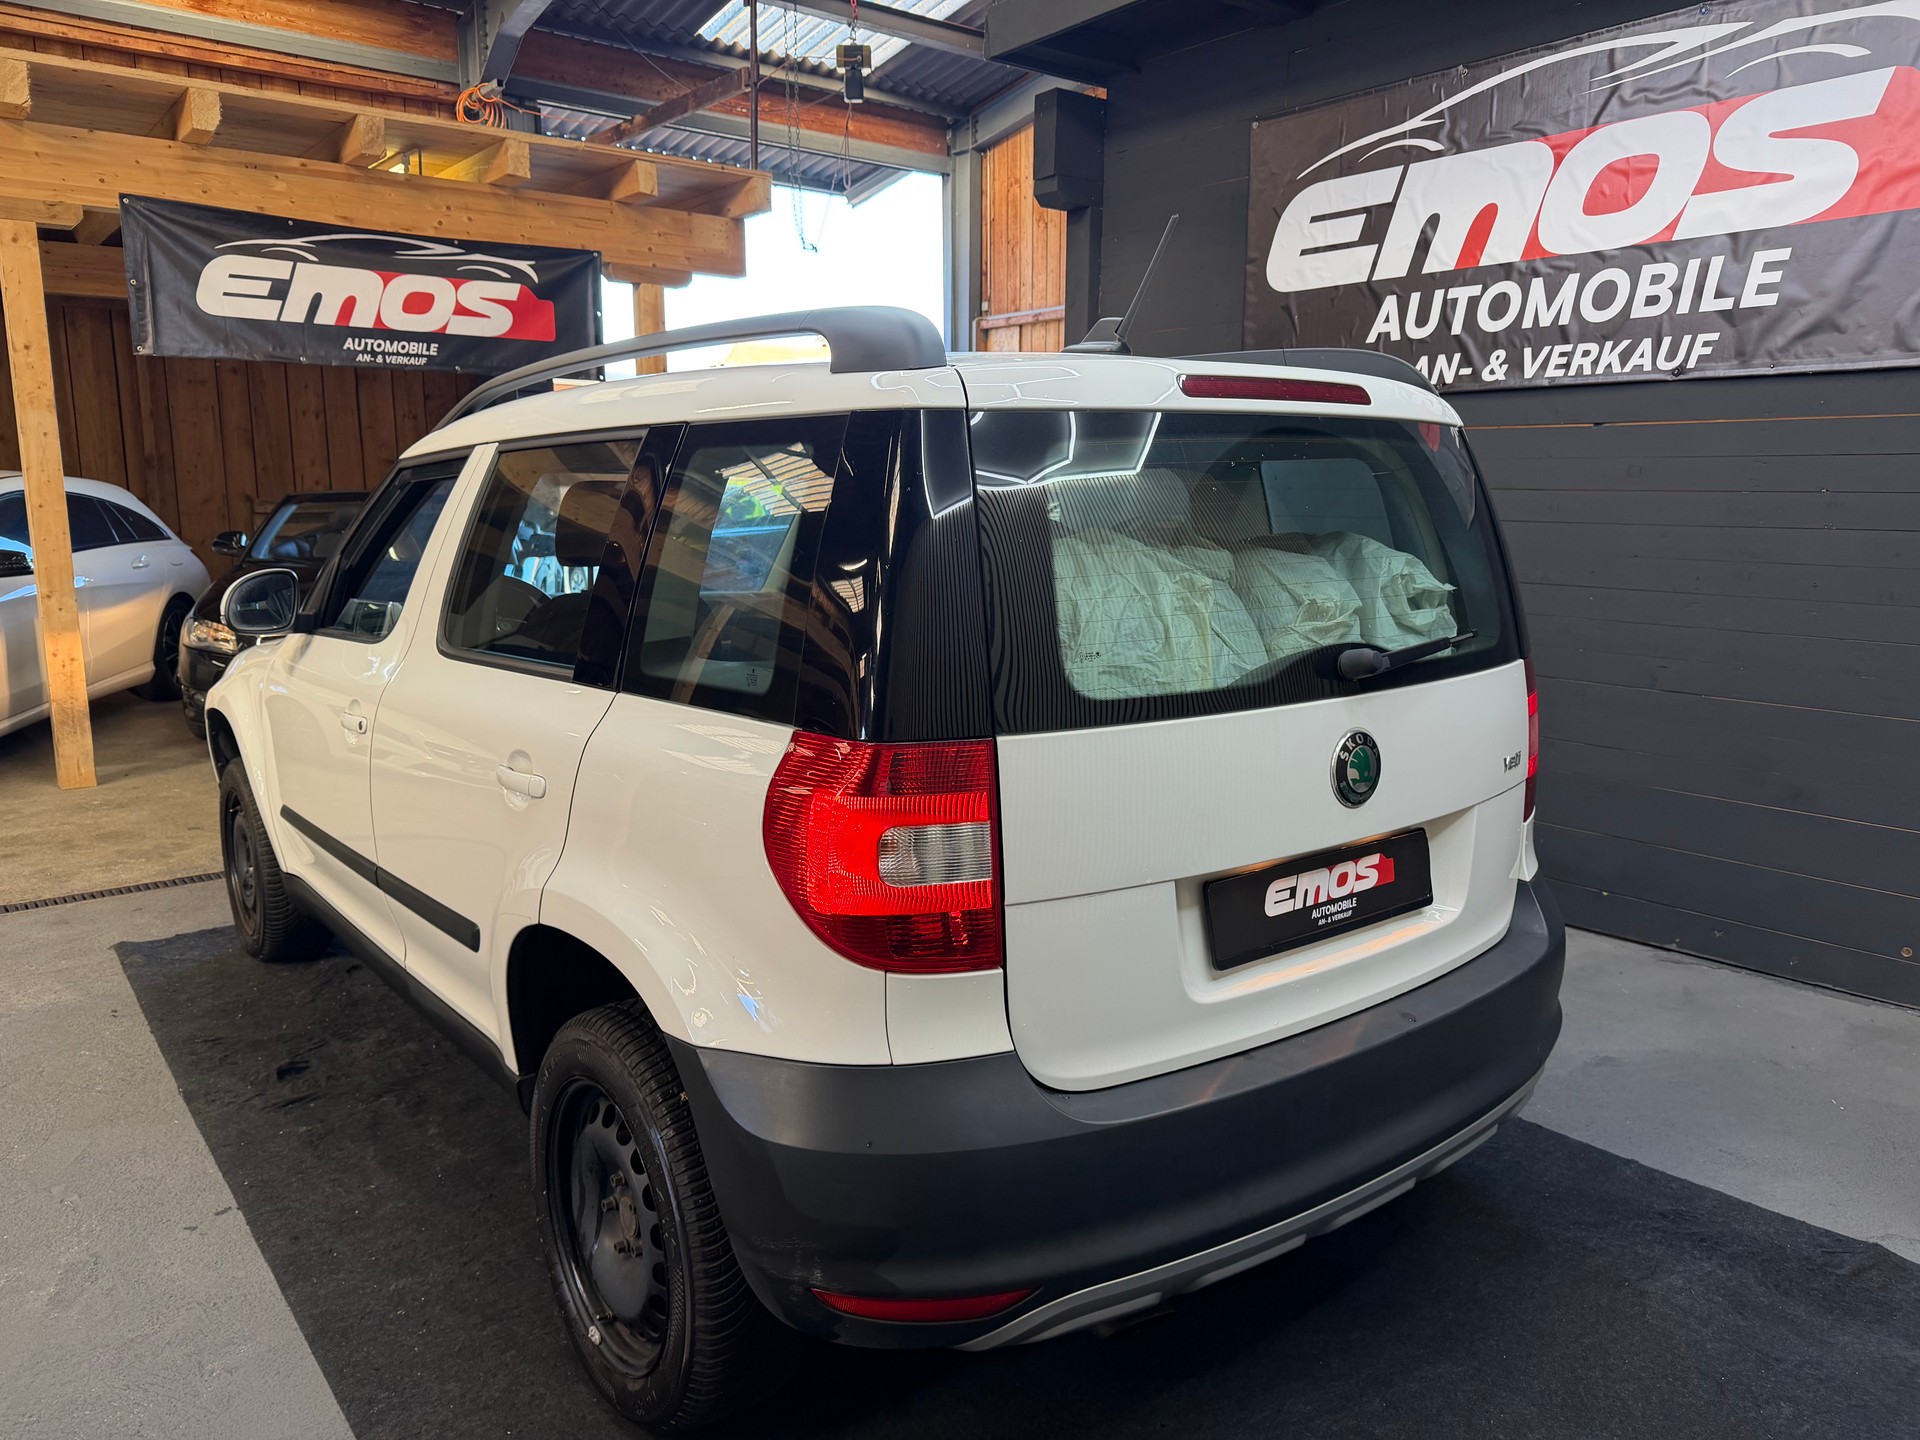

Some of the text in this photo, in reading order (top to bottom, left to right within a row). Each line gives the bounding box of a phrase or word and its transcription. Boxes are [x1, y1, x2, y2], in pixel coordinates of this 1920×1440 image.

[1365, 247, 1792, 344] AUTOMOBILE
[343, 337, 439, 356] AUTOMOBILE
[1481, 348, 1509, 383] &
[1522, 332, 1720, 379] VERKAUF
[356, 353, 428, 366] AN- & VERKAUF
[1311, 897, 1357, 919] AUTOMOBILE
